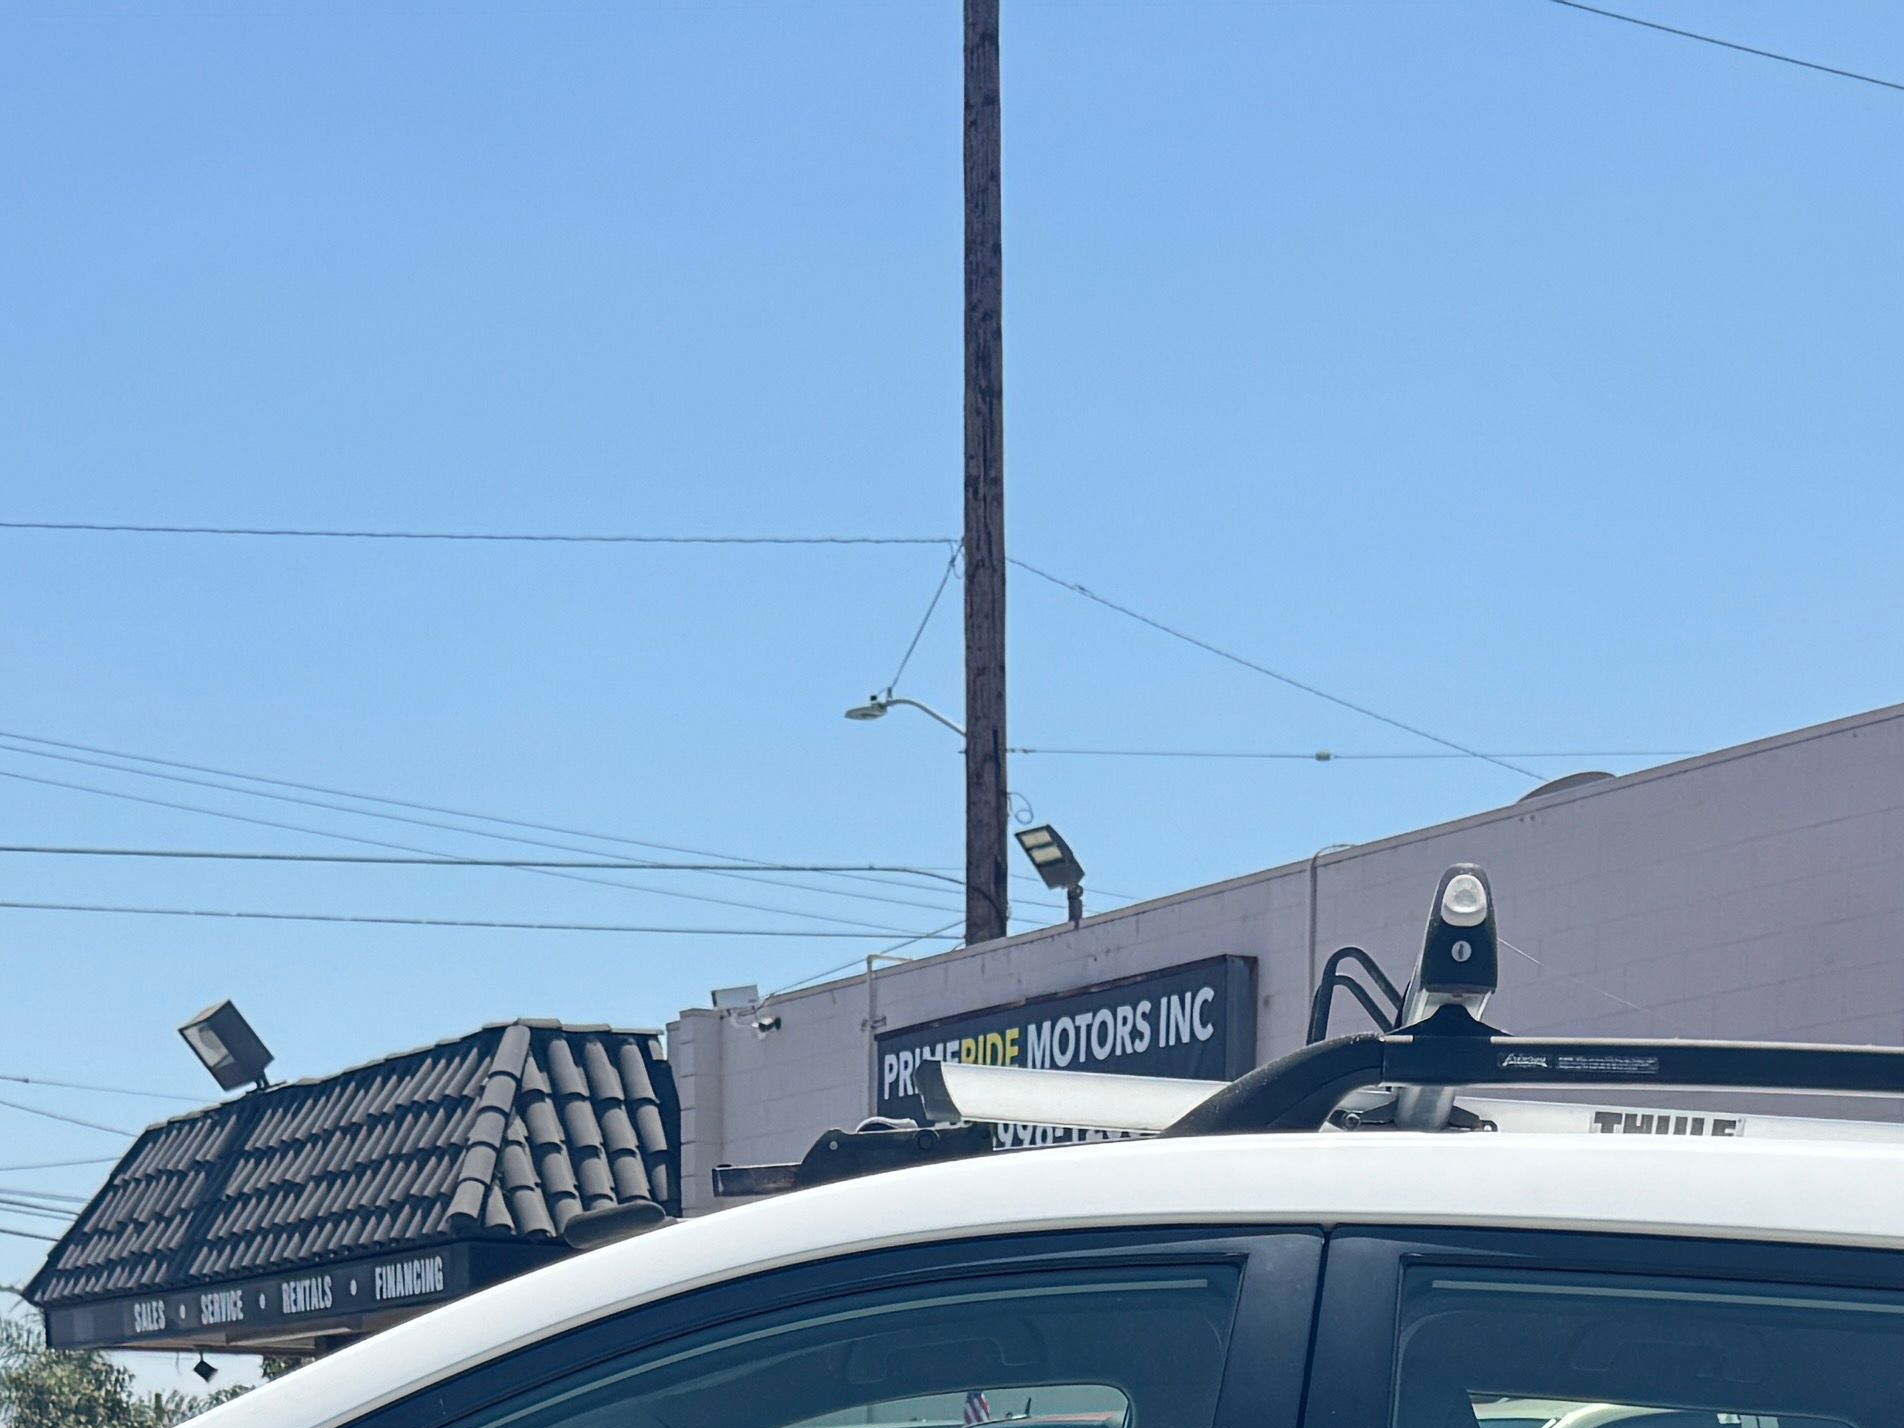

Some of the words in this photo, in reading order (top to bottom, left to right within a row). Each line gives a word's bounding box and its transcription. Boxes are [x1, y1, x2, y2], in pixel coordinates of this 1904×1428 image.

[1027, 1000, 1152, 1070] MOTORS
[1159, 986, 1215, 1048] INC
[133, 1300, 166, 1333] SALES
[200, 1289, 245, 1325] SERVICE
[282, 1274, 333, 1315] RENTALS
[374, 1255, 445, 1301] FINANCING
